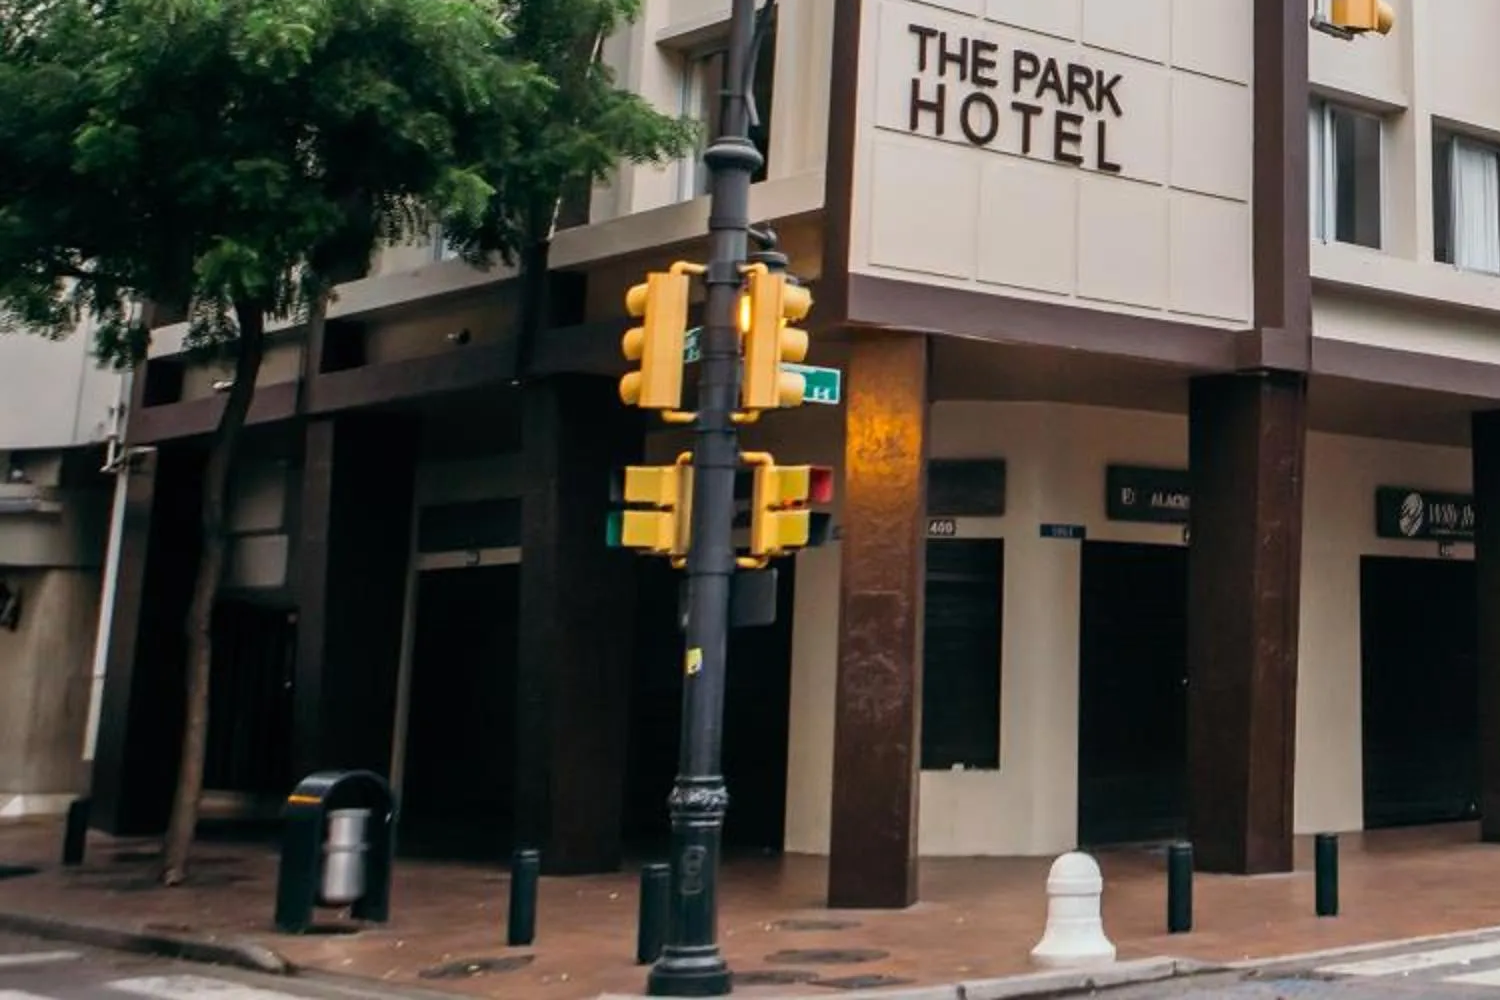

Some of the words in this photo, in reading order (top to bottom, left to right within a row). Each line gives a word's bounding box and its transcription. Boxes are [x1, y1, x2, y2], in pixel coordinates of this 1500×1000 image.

[908, 23, 999, 88] THE
[1013, 50, 1123, 118] PARK
[908, 77, 1122, 173] HOTEL
